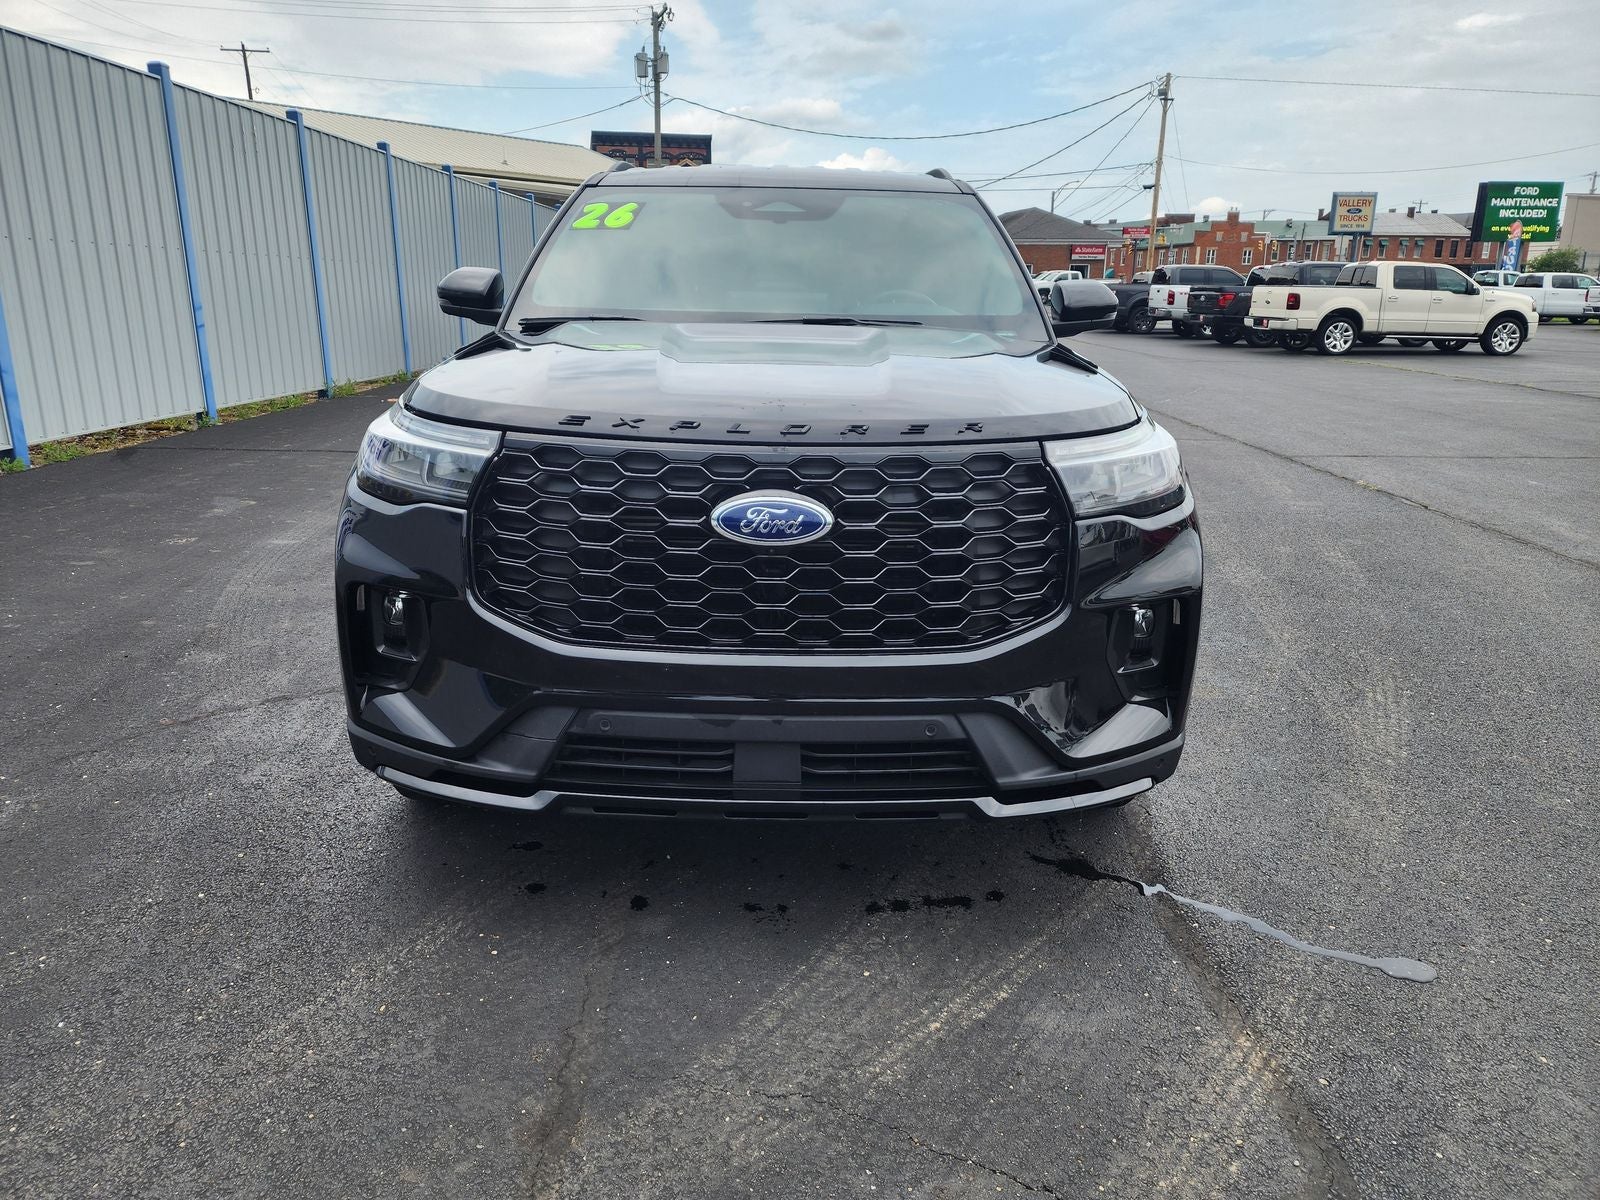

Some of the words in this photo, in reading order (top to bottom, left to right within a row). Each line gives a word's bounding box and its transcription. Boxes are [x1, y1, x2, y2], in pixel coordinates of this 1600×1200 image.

[1514, 186, 1539, 195] FORD
[1339, 199, 1373, 207] VALLERY
[1491, 198, 1558, 207] MAINTENANCE
[572, 202, 638, 228] 26
[1339, 214, 1368, 222] TRUCKS
[1499, 209, 1547, 218] INCLUDED!
[558, 415, 984, 435] EXPLORER
[740, 506, 804, 534] Ford
